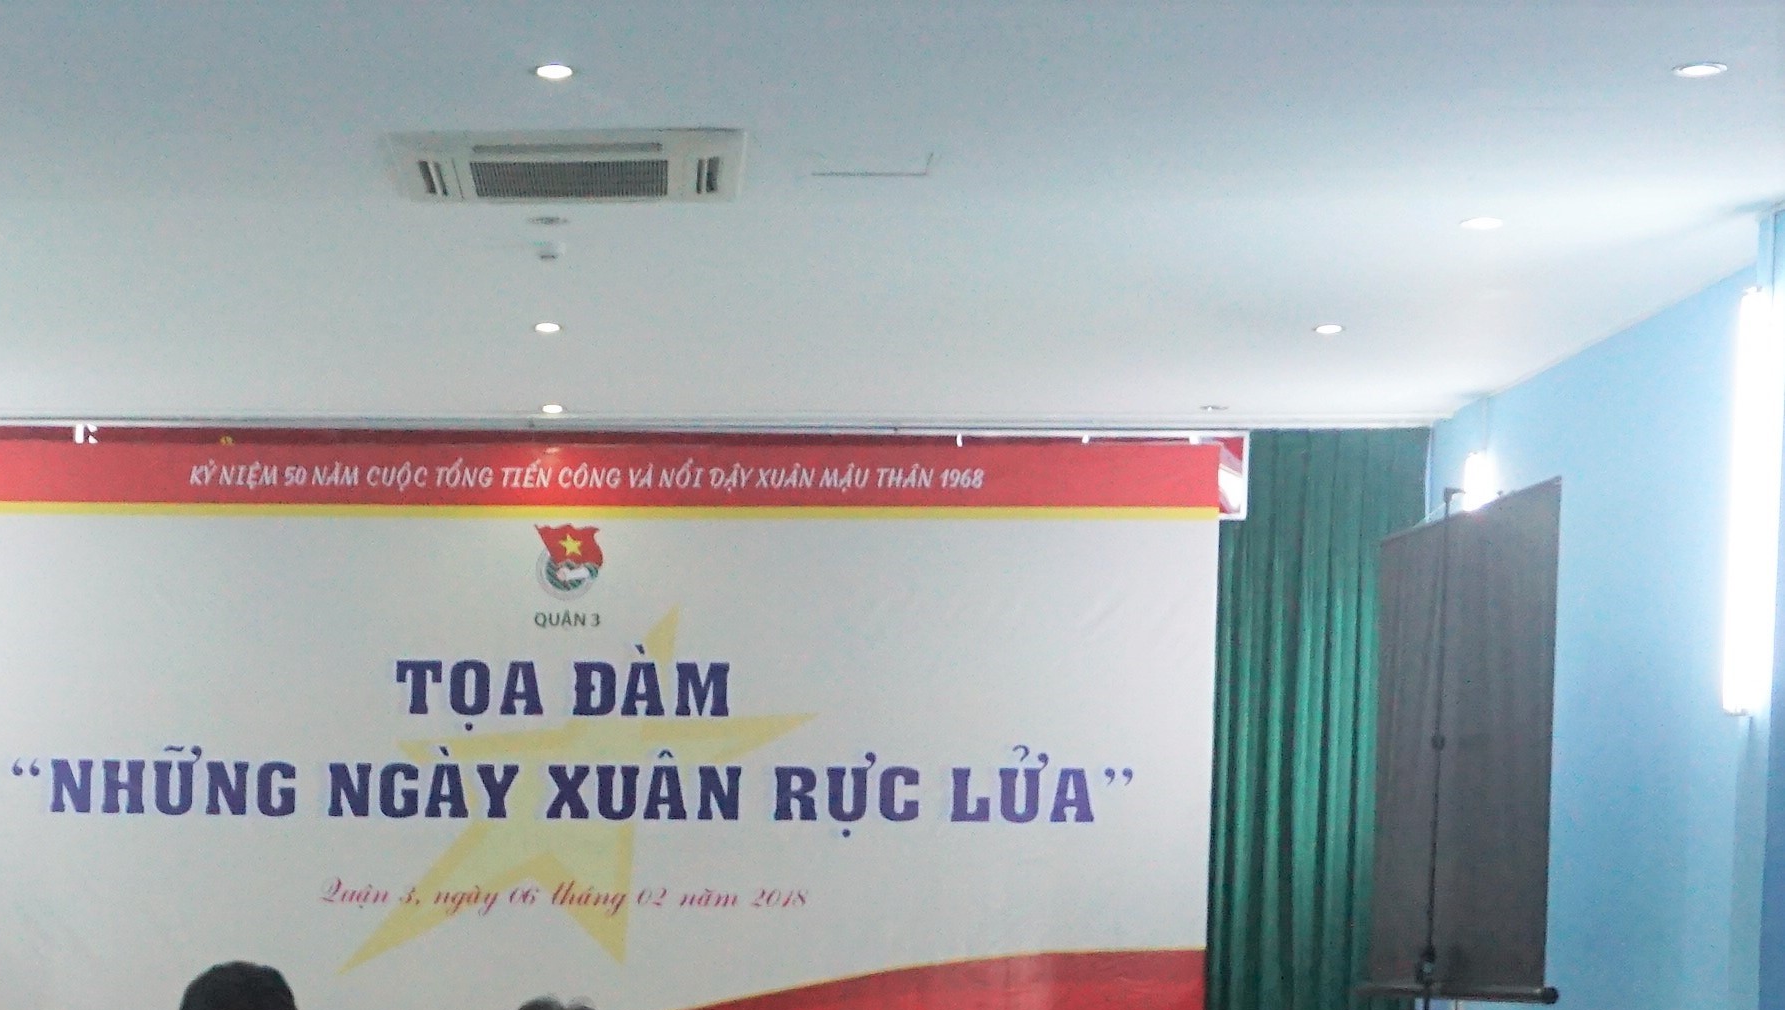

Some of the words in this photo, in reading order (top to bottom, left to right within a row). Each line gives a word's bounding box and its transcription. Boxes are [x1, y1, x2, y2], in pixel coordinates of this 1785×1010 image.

[218, 461, 278, 490] NIỆM
[284, 465, 307, 487] 50
[312, 461, 359, 487] NĂM
[366, 461, 428, 492] CUỘC
[501, 458, 552, 488] TIẾN
[558, 462, 622, 489] CÔNG
[628, 462, 654, 488] VÀ
[659, 457, 703, 489] NỔI
[709, 462, 753, 492] DẬY
[756, 462, 815, 489] XUÂN
[819, 462, 870, 492] MẬU
[876, 463, 934, 489] THÂN
[940, 467, 984, 489] 1968
[591, 612, 601, 627] 3
[396, 659, 544, 731] TỌA
[572, 644, 730, 717] ĐÀM
[328, 746, 520, 819] NGÀY
[546, 749, 742, 821] XUÂN
[773, 751, 921, 838] RỰC
[320, 876, 389, 909] Quận
[434, 885, 499, 916] ngày
[509, 887, 540, 904] 06
[551, 879, 626, 916] tháng
[636, 887, 667, 907] 02
[679, 887, 739, 907] năm
[751, 887, 809, 908] 2018
